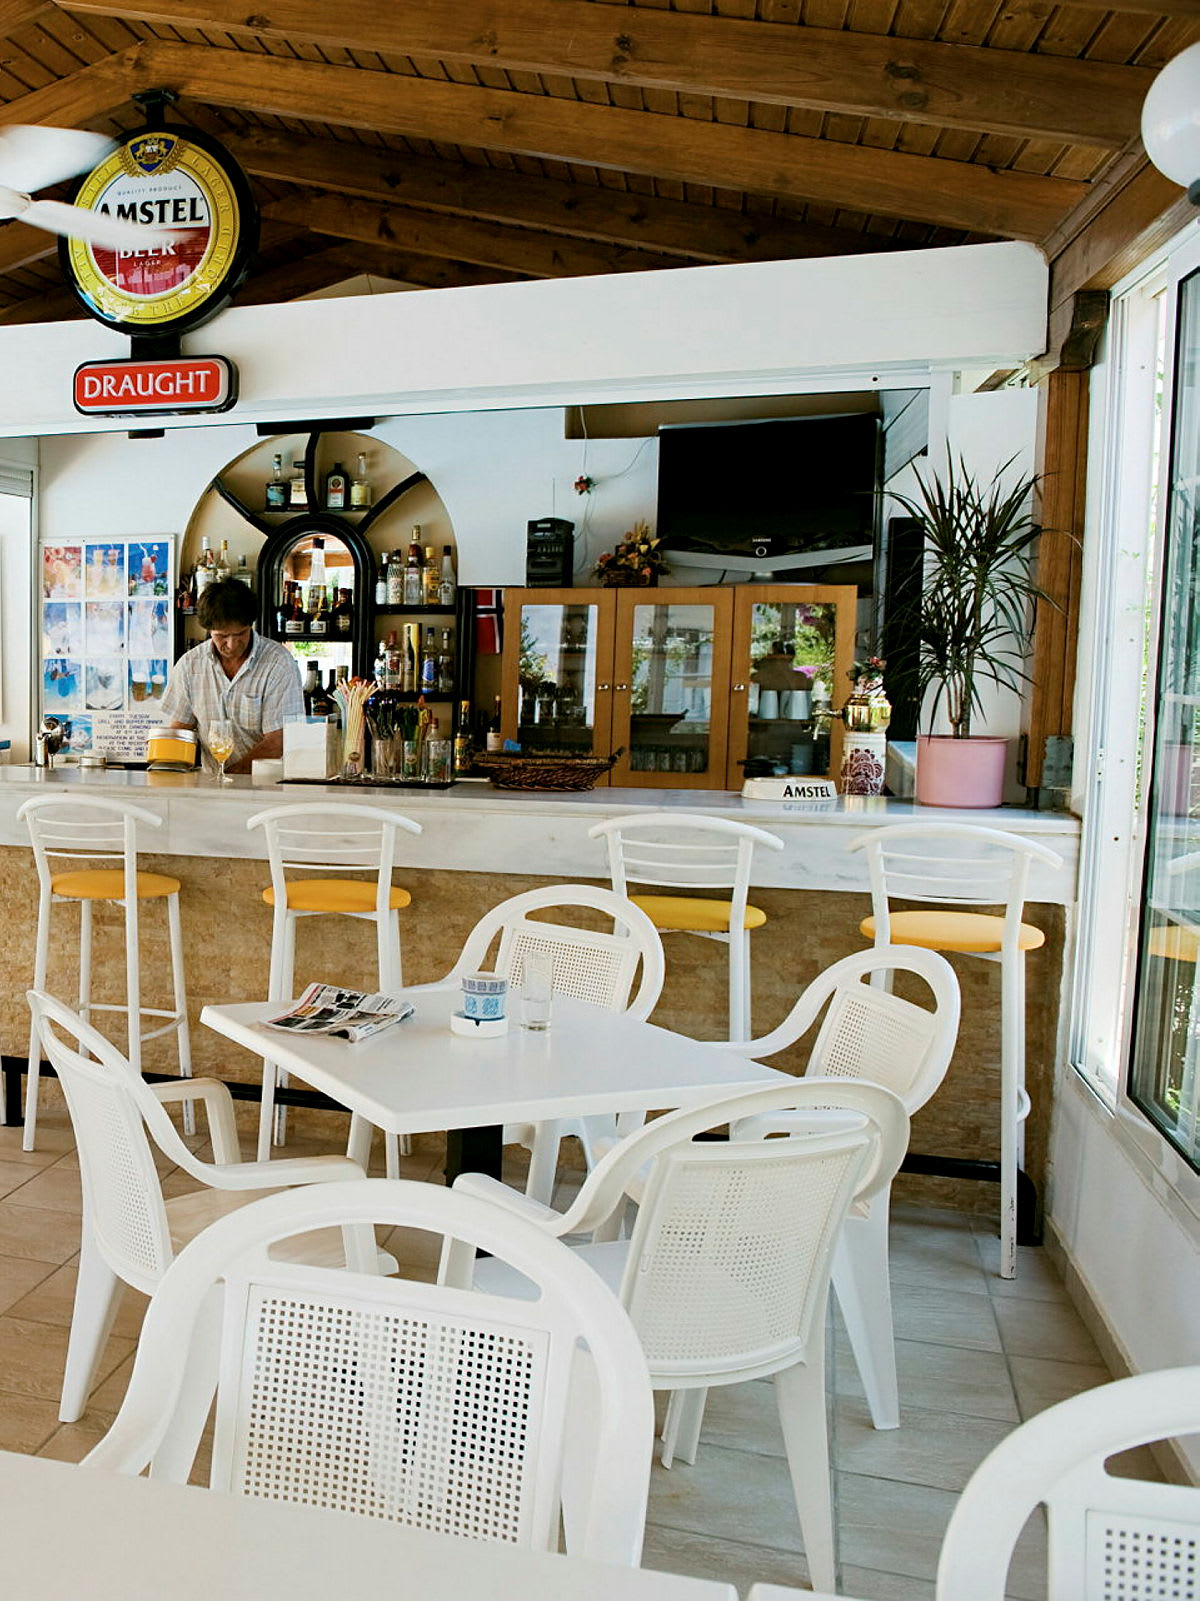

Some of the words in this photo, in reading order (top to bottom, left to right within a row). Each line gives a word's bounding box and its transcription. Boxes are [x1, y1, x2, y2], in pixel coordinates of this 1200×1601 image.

[148, 184, 182, 193] PRODUCT
[100, 197, 204, 225] AMSTEL
[133, 259, 161, 267] LAGER
[83, 369, 212, 399] DRAUGHT
[783, 785, 831, 798] AMSTEL
